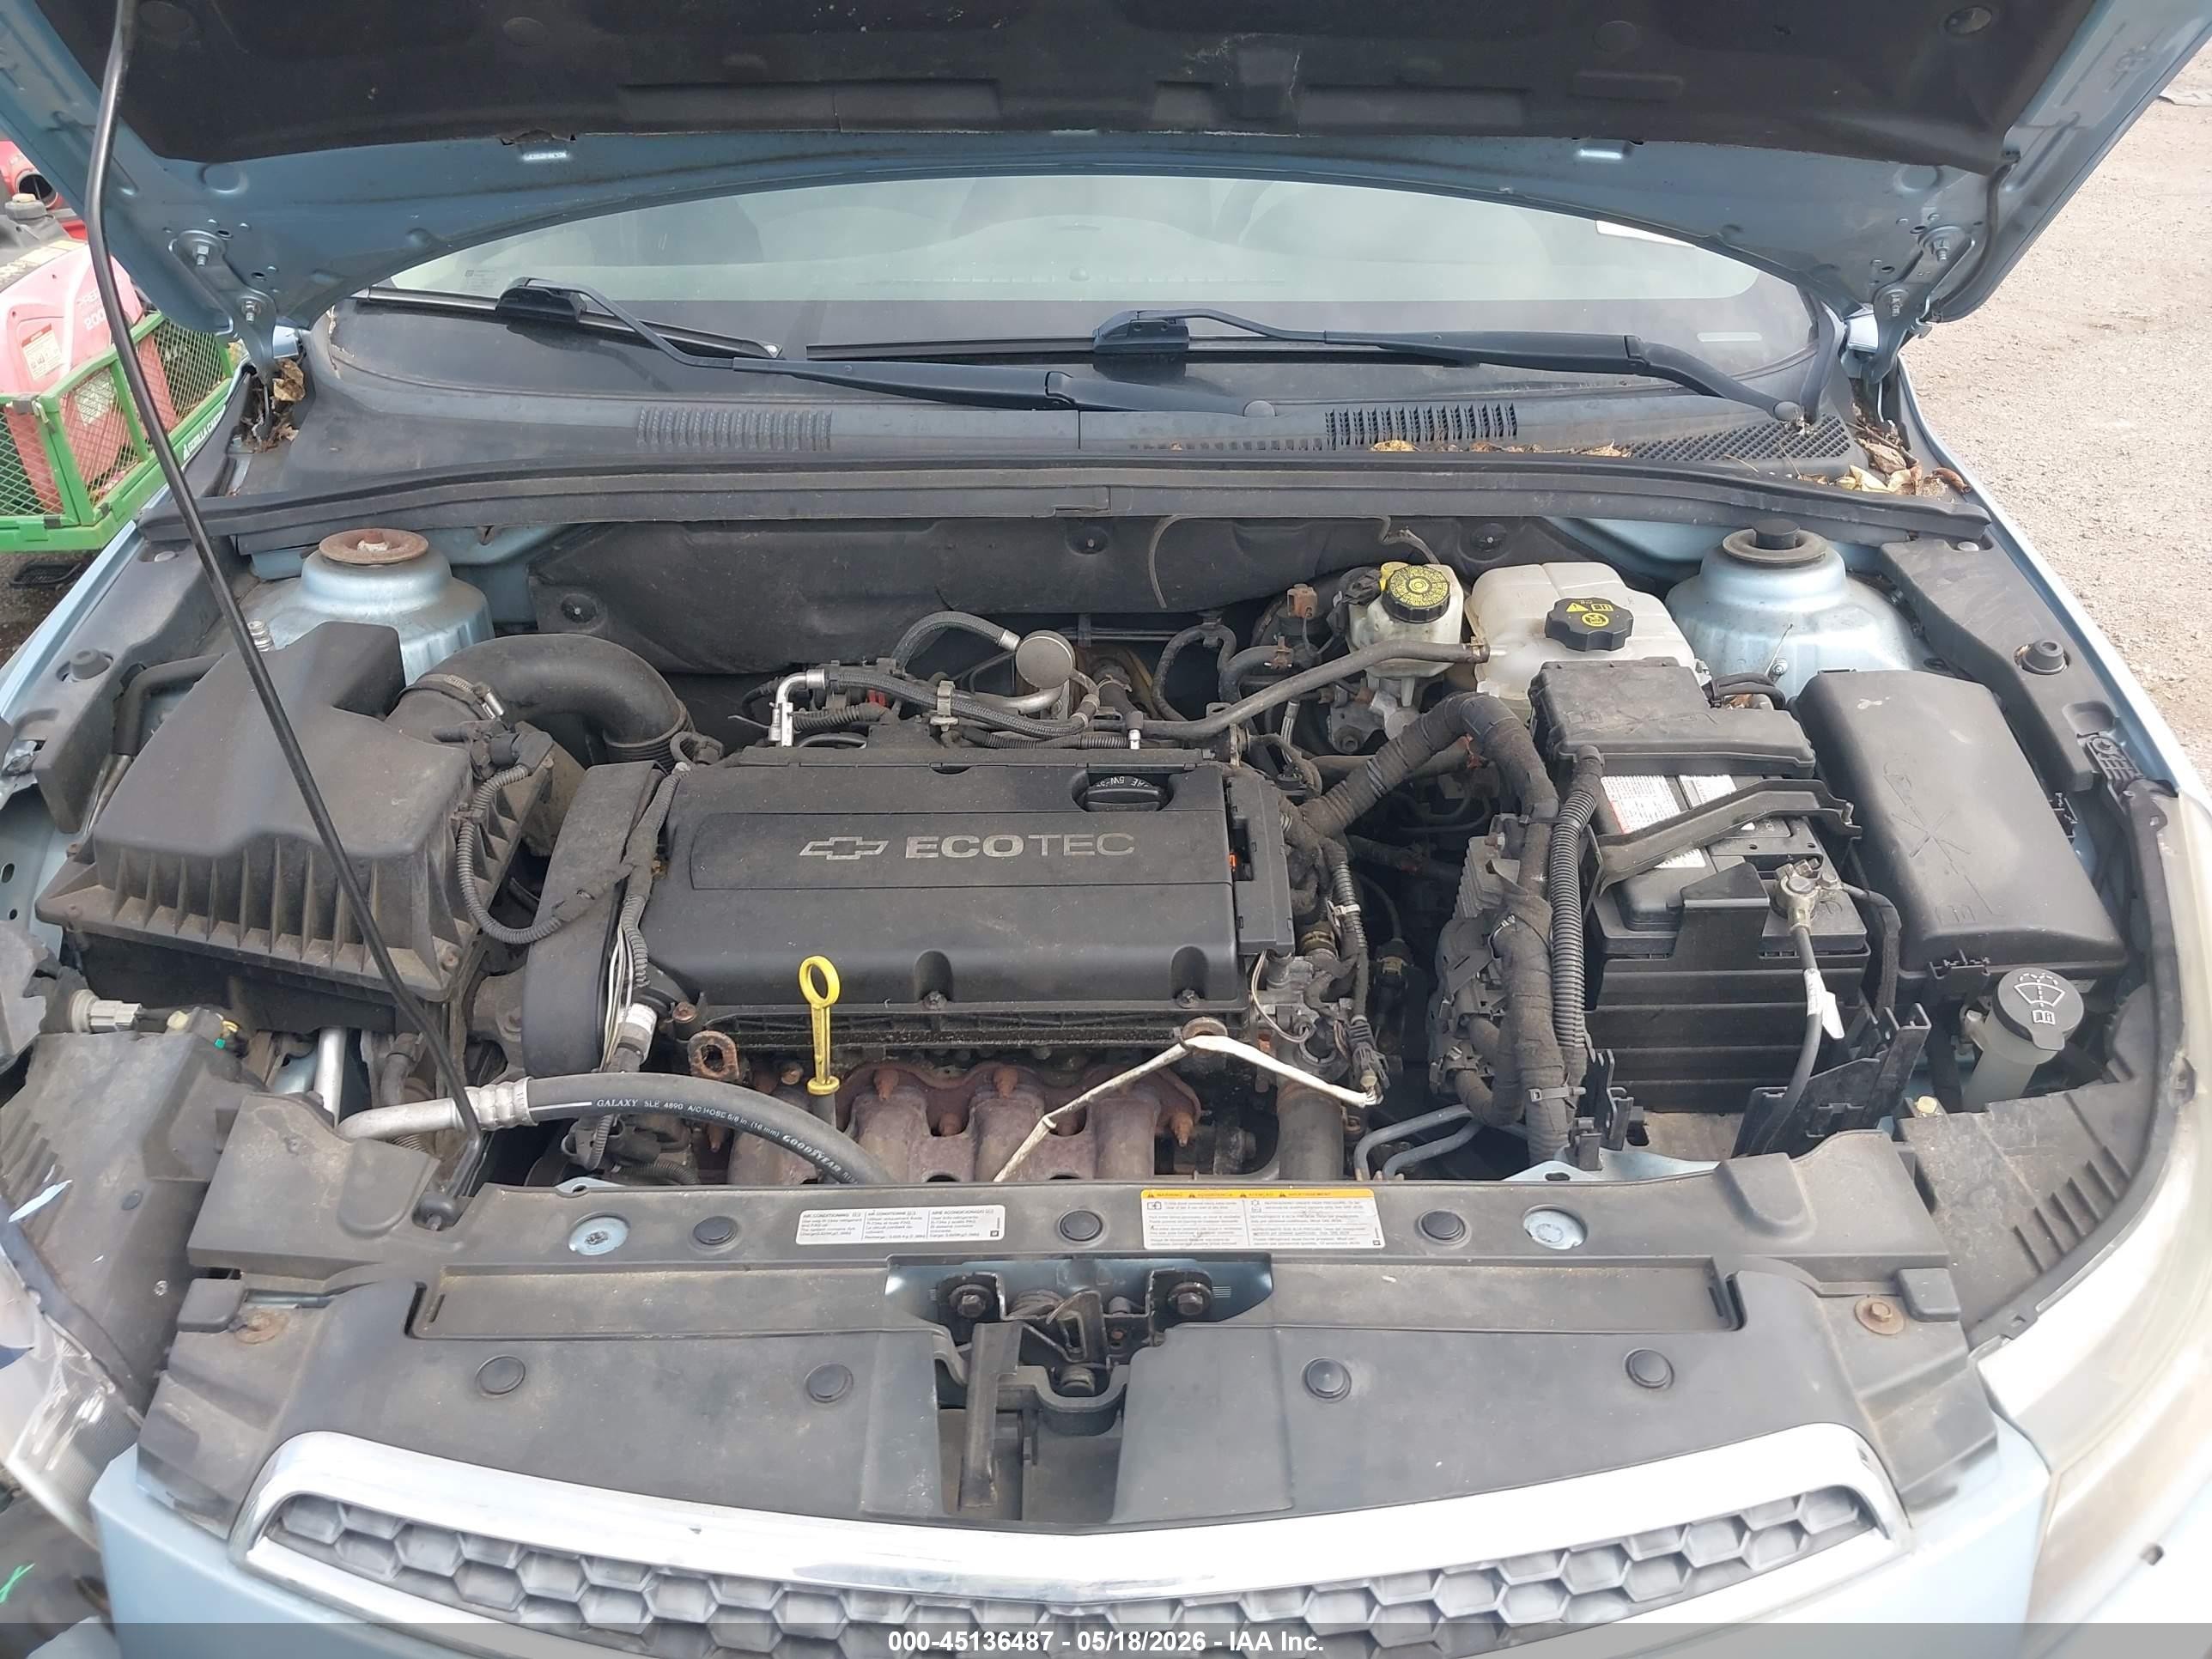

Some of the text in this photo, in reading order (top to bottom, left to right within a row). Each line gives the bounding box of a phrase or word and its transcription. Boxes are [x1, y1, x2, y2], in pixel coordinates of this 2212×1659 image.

[906, 832, 1135, 859] ECOTEC
[596, 1099, 638, 1108] GALAXY
[687, 1105, 702, 1114] A/C
